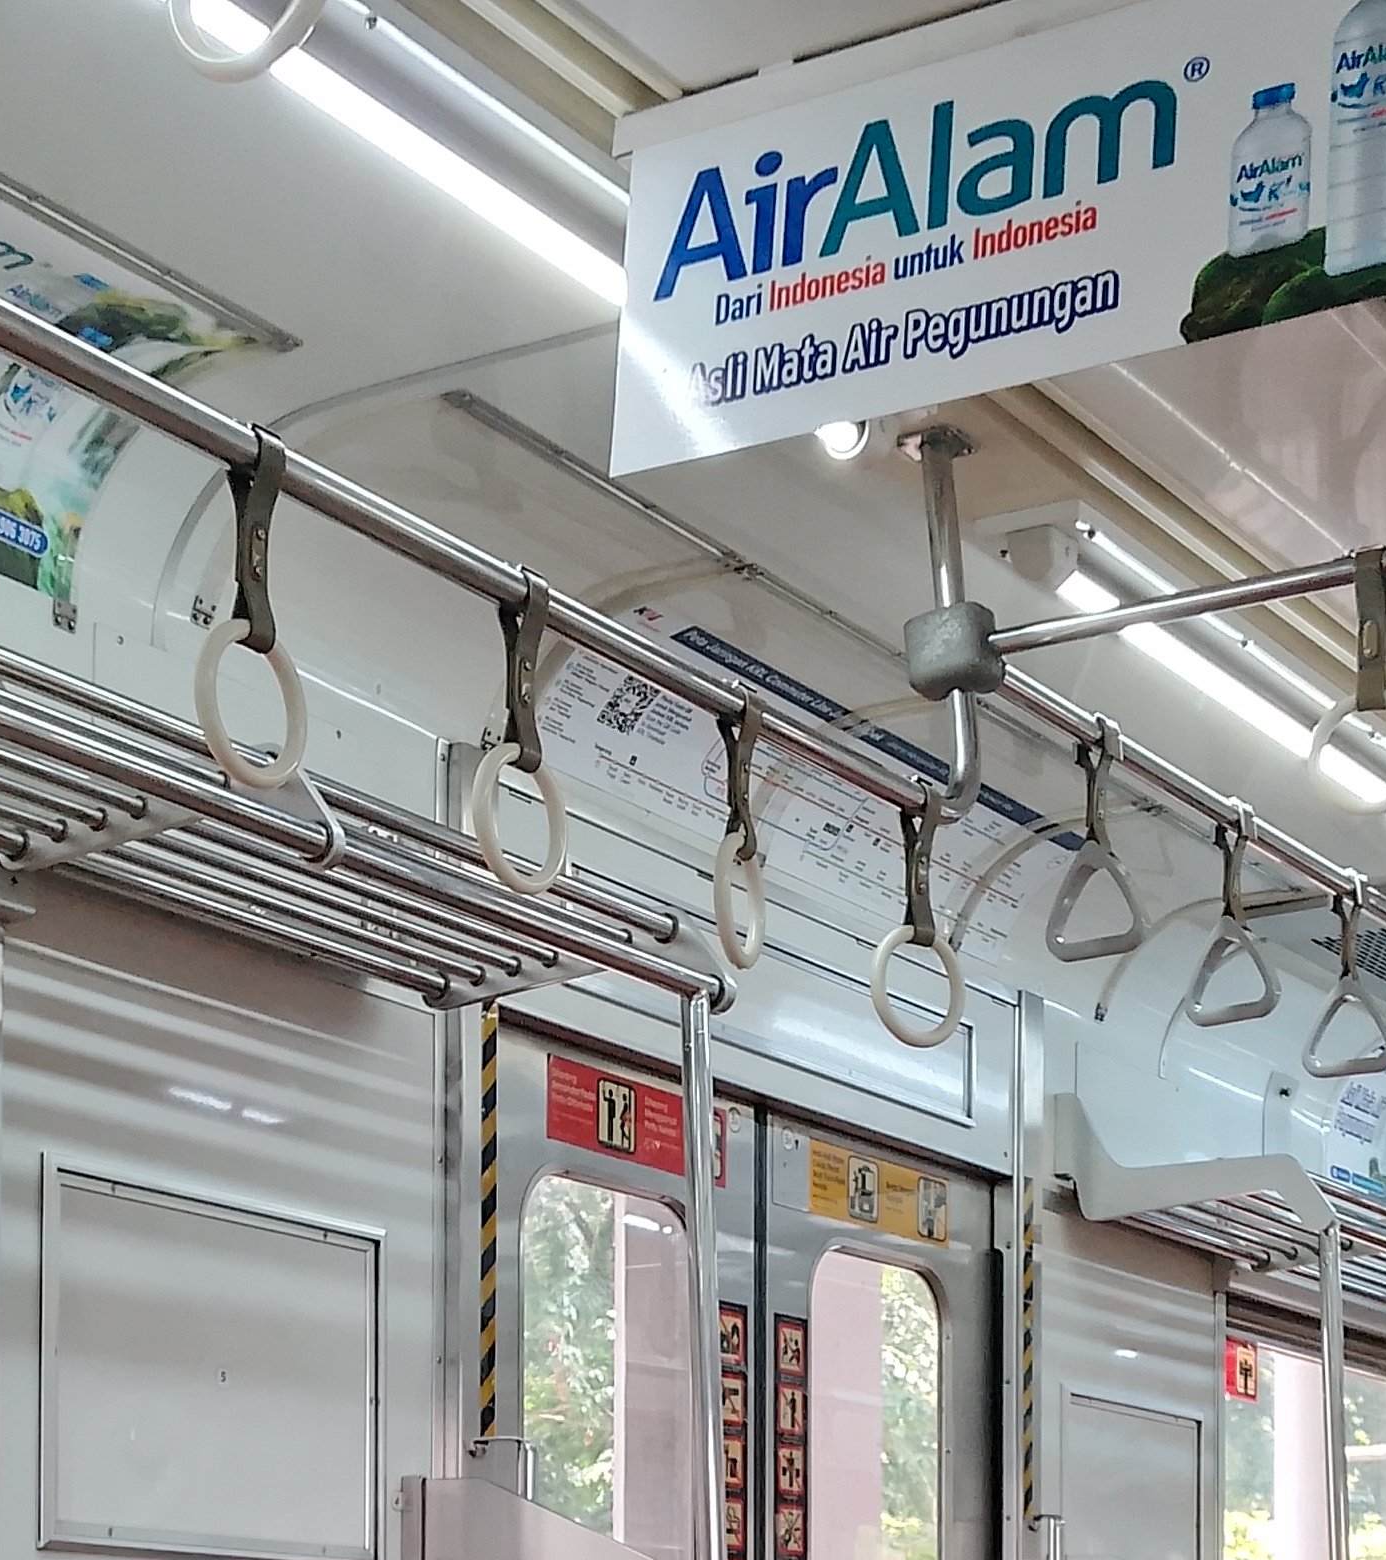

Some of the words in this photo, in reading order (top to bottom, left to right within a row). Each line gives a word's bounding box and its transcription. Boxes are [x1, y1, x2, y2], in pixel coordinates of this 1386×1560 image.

[1236, 153, 1304, 183] AirAlam
[715, 283, 763, 326] Dari
[769, 255, 886, 312] Indonesia
[894, 234, 964, 280] untuk
[973, 200, 1098, 260] Indonesia
[686, 350, 749, 406] Asli
[753, 333, 838, 396] Mata
[842, 318, 898, 374] Air
[903, 269, 1119, 360] Pegunungan
[18, 527, 43, 552] 3075
